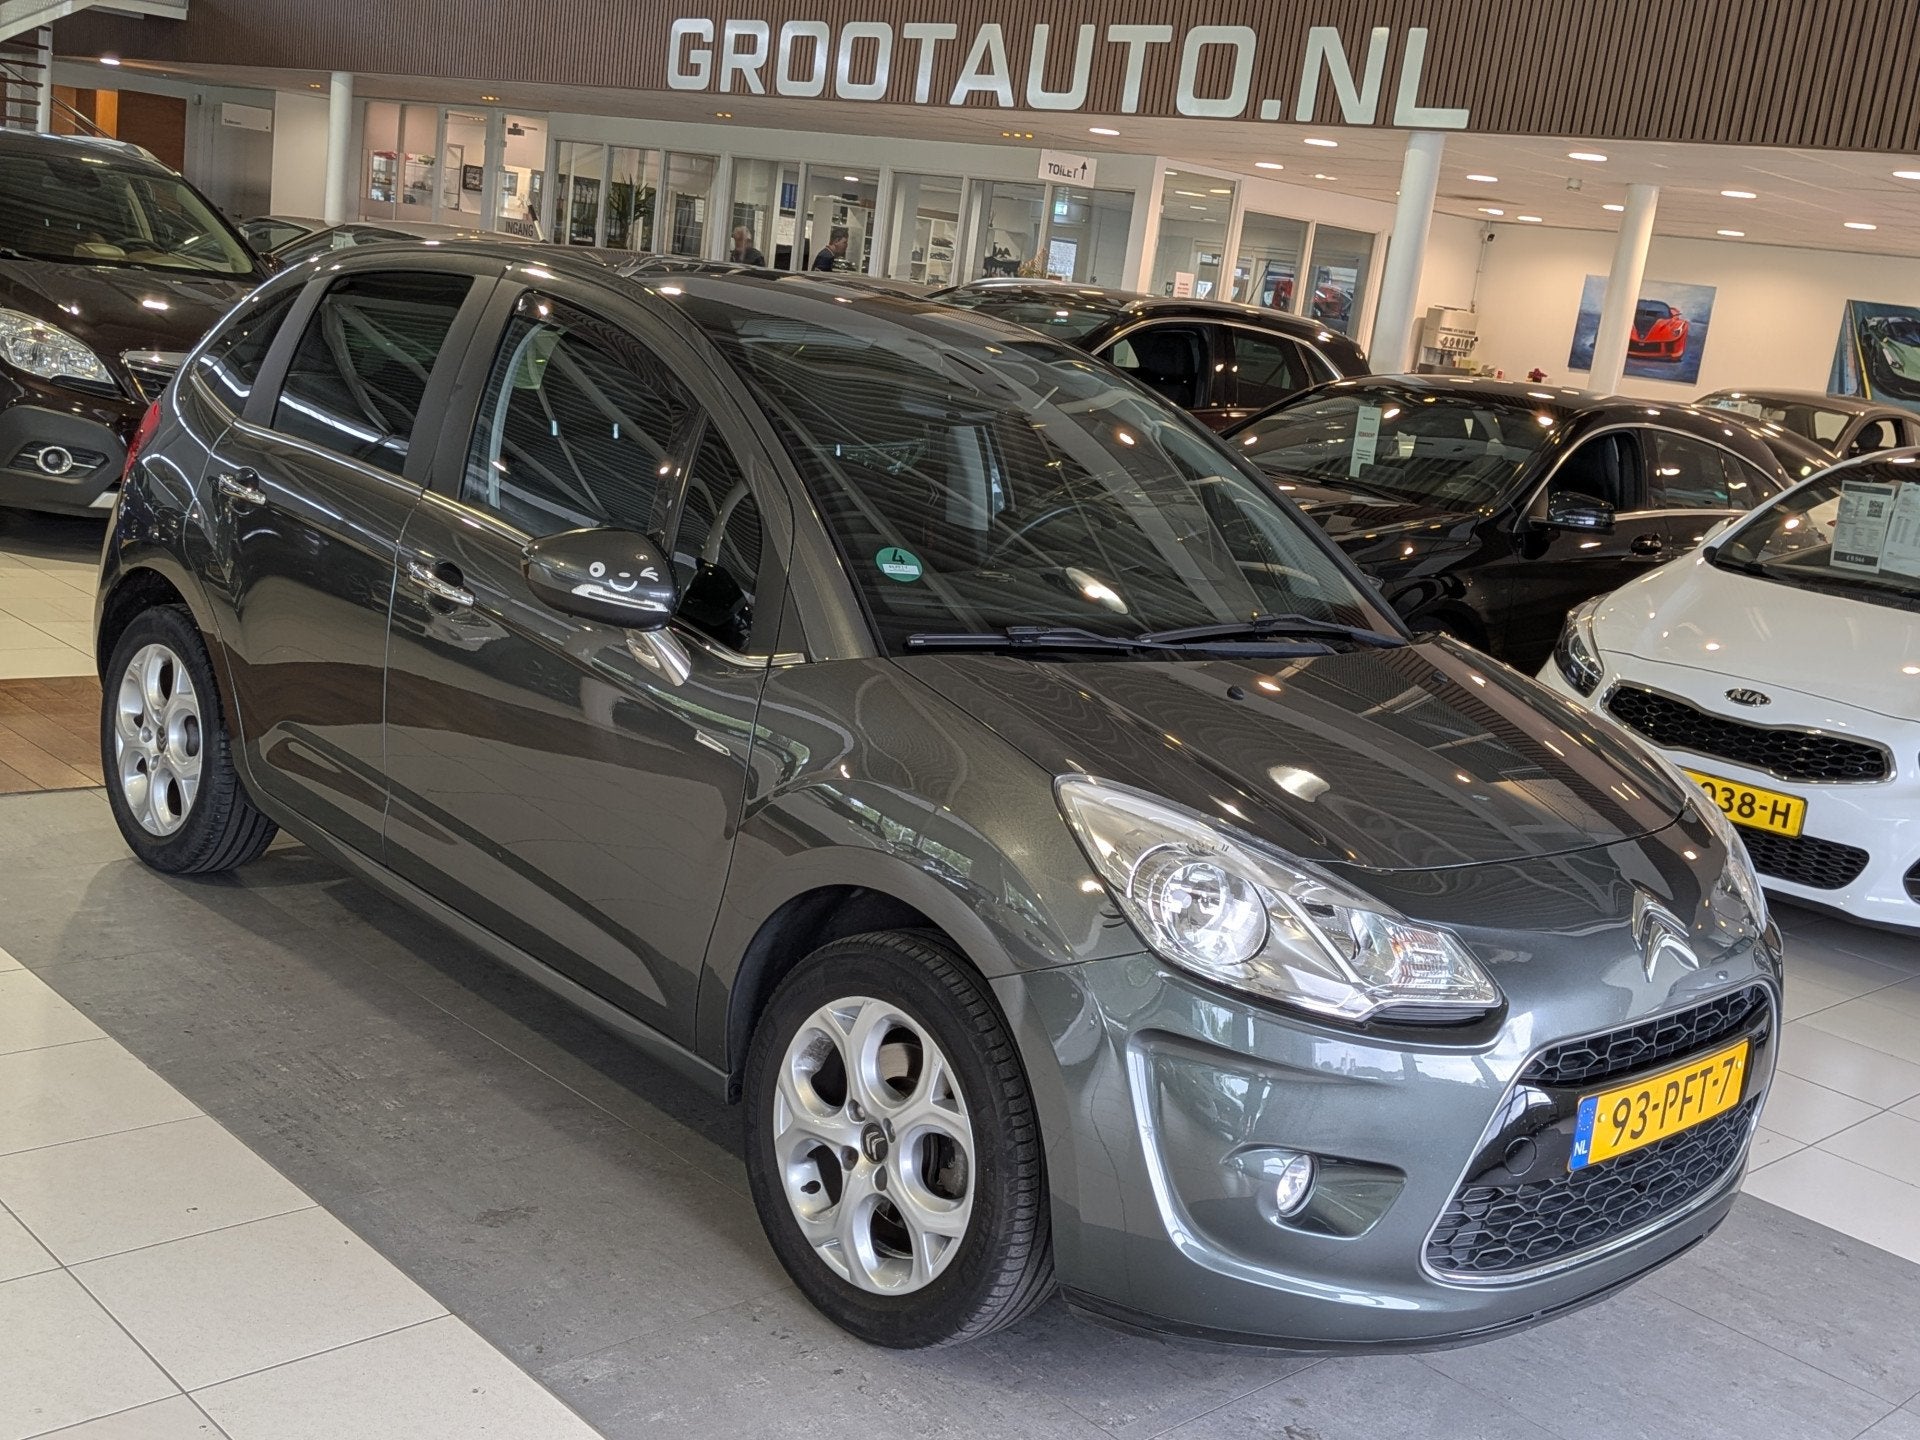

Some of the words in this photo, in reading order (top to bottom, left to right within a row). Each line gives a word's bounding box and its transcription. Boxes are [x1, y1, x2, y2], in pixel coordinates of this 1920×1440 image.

[667, 18, 1470, 129] GROOTAUTO.NL
[1048, 162, 1079, 178] TOILET
[505, 221, 534, 237] INGANG
[892, 549, 905, 564] 4
[1730, 688, 1763, 704] KIA
[1612, 1056, 1736, 1147] 93-PFT-7
[1574, 1140, 1588, 1156] NL
